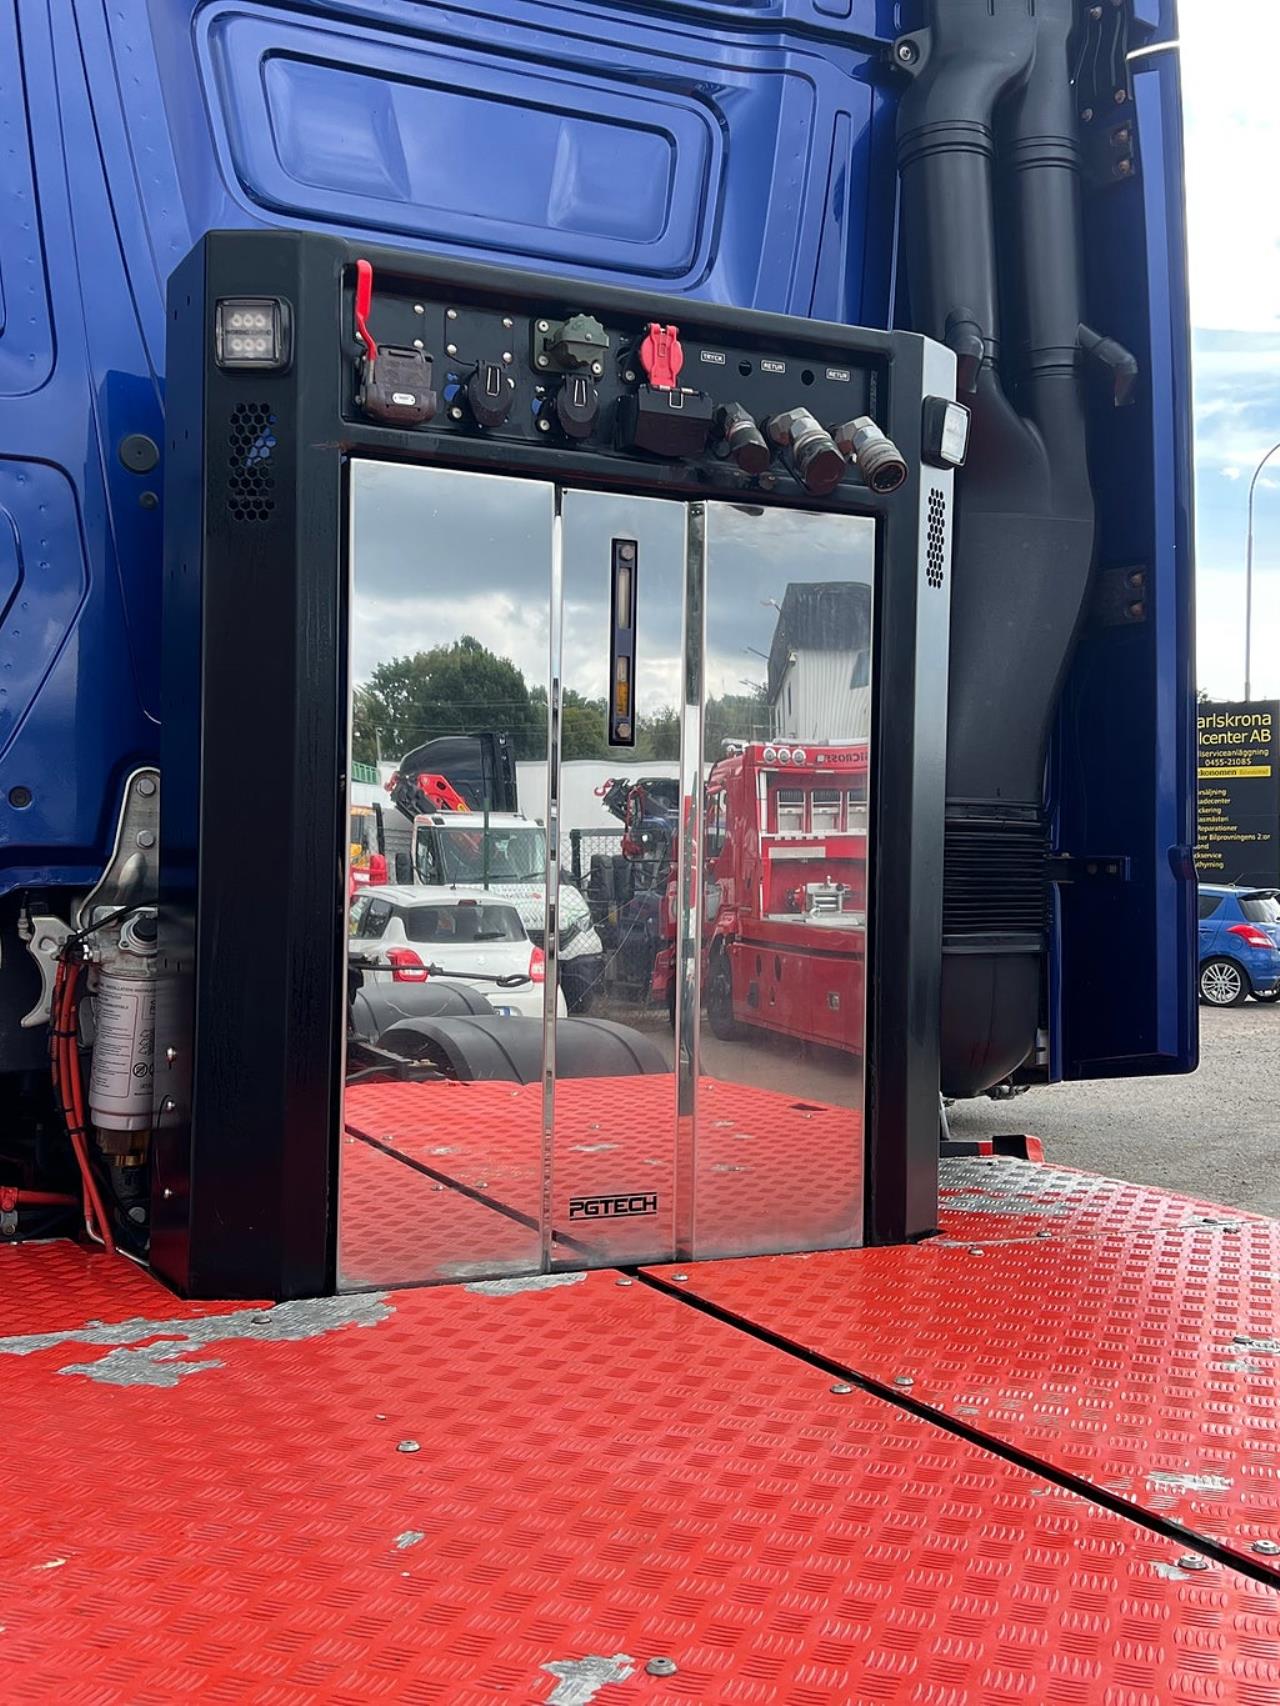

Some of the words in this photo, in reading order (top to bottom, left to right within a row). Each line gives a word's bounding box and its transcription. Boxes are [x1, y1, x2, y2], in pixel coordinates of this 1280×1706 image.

[763, 362, 783, 371] RETUR
[828, 371, 848, 379] RETUR
[1197, 712, 1272, 729] arlskrona
[1199, 731, 1249, 745] lcenter
[1249, 729, 1272, 743] AB
[1199, 769, 1237, 777] konomen
[1198, 807, 1222, 815] ckering
[569, 1195, 657, 1218] PGTECH
